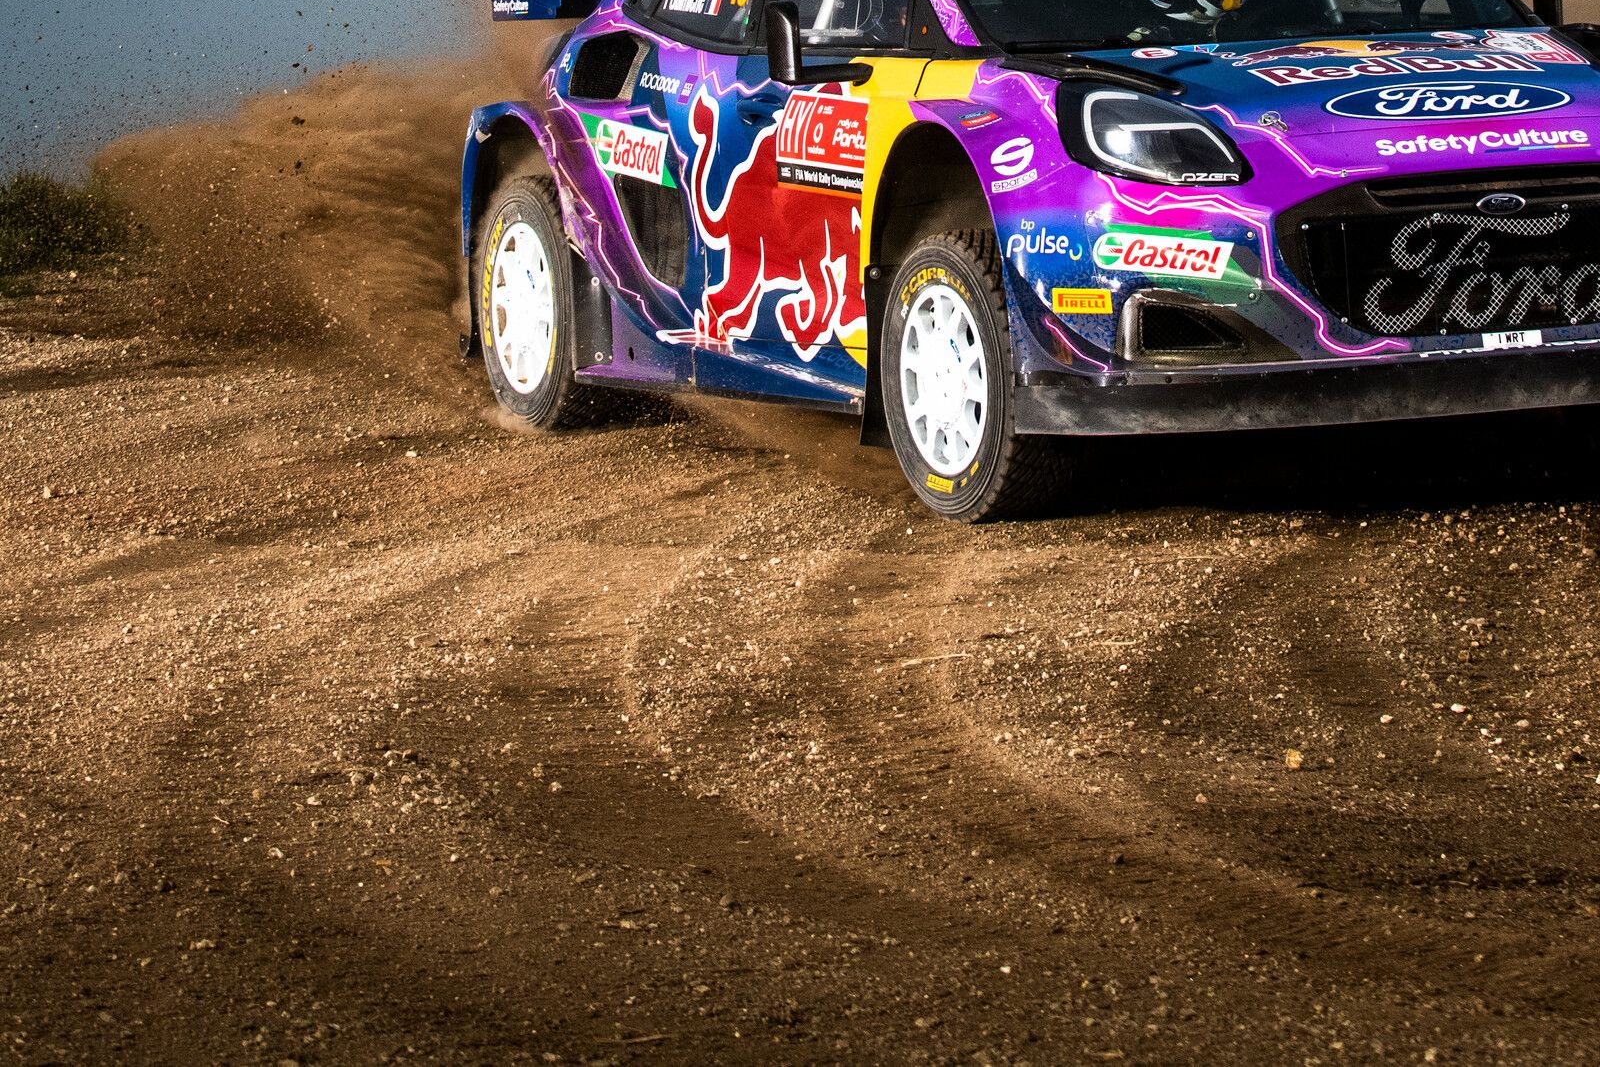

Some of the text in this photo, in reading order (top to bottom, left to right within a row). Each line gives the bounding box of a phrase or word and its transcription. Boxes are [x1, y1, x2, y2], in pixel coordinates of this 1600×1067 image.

[493, 0, 529, 15] SafetyCulture
[1250, 55, 1544, 86] Red Bull
[639, 72, 681, 95] ROCKDOOR
[1375, 84, 1530, 115] Ford
[781, 99, 814, 153] HY
[612, 129, 663, 176] Castrol
[1375, 128, 1589, 155] SafetyCulture
[804, 170, 818, 183] World
[819, 172, 831, 186] Rally
[993, 171, 1036, 192] sparco
[1020, 218, 1035, 231] bp
[1006, 227, 1069, 258] pulse
[1122, 239, 1223, 274] Castrol
[1057, 293, 1106, 309] PIRELLI
[1505, 331, 1526, 344] WRT
